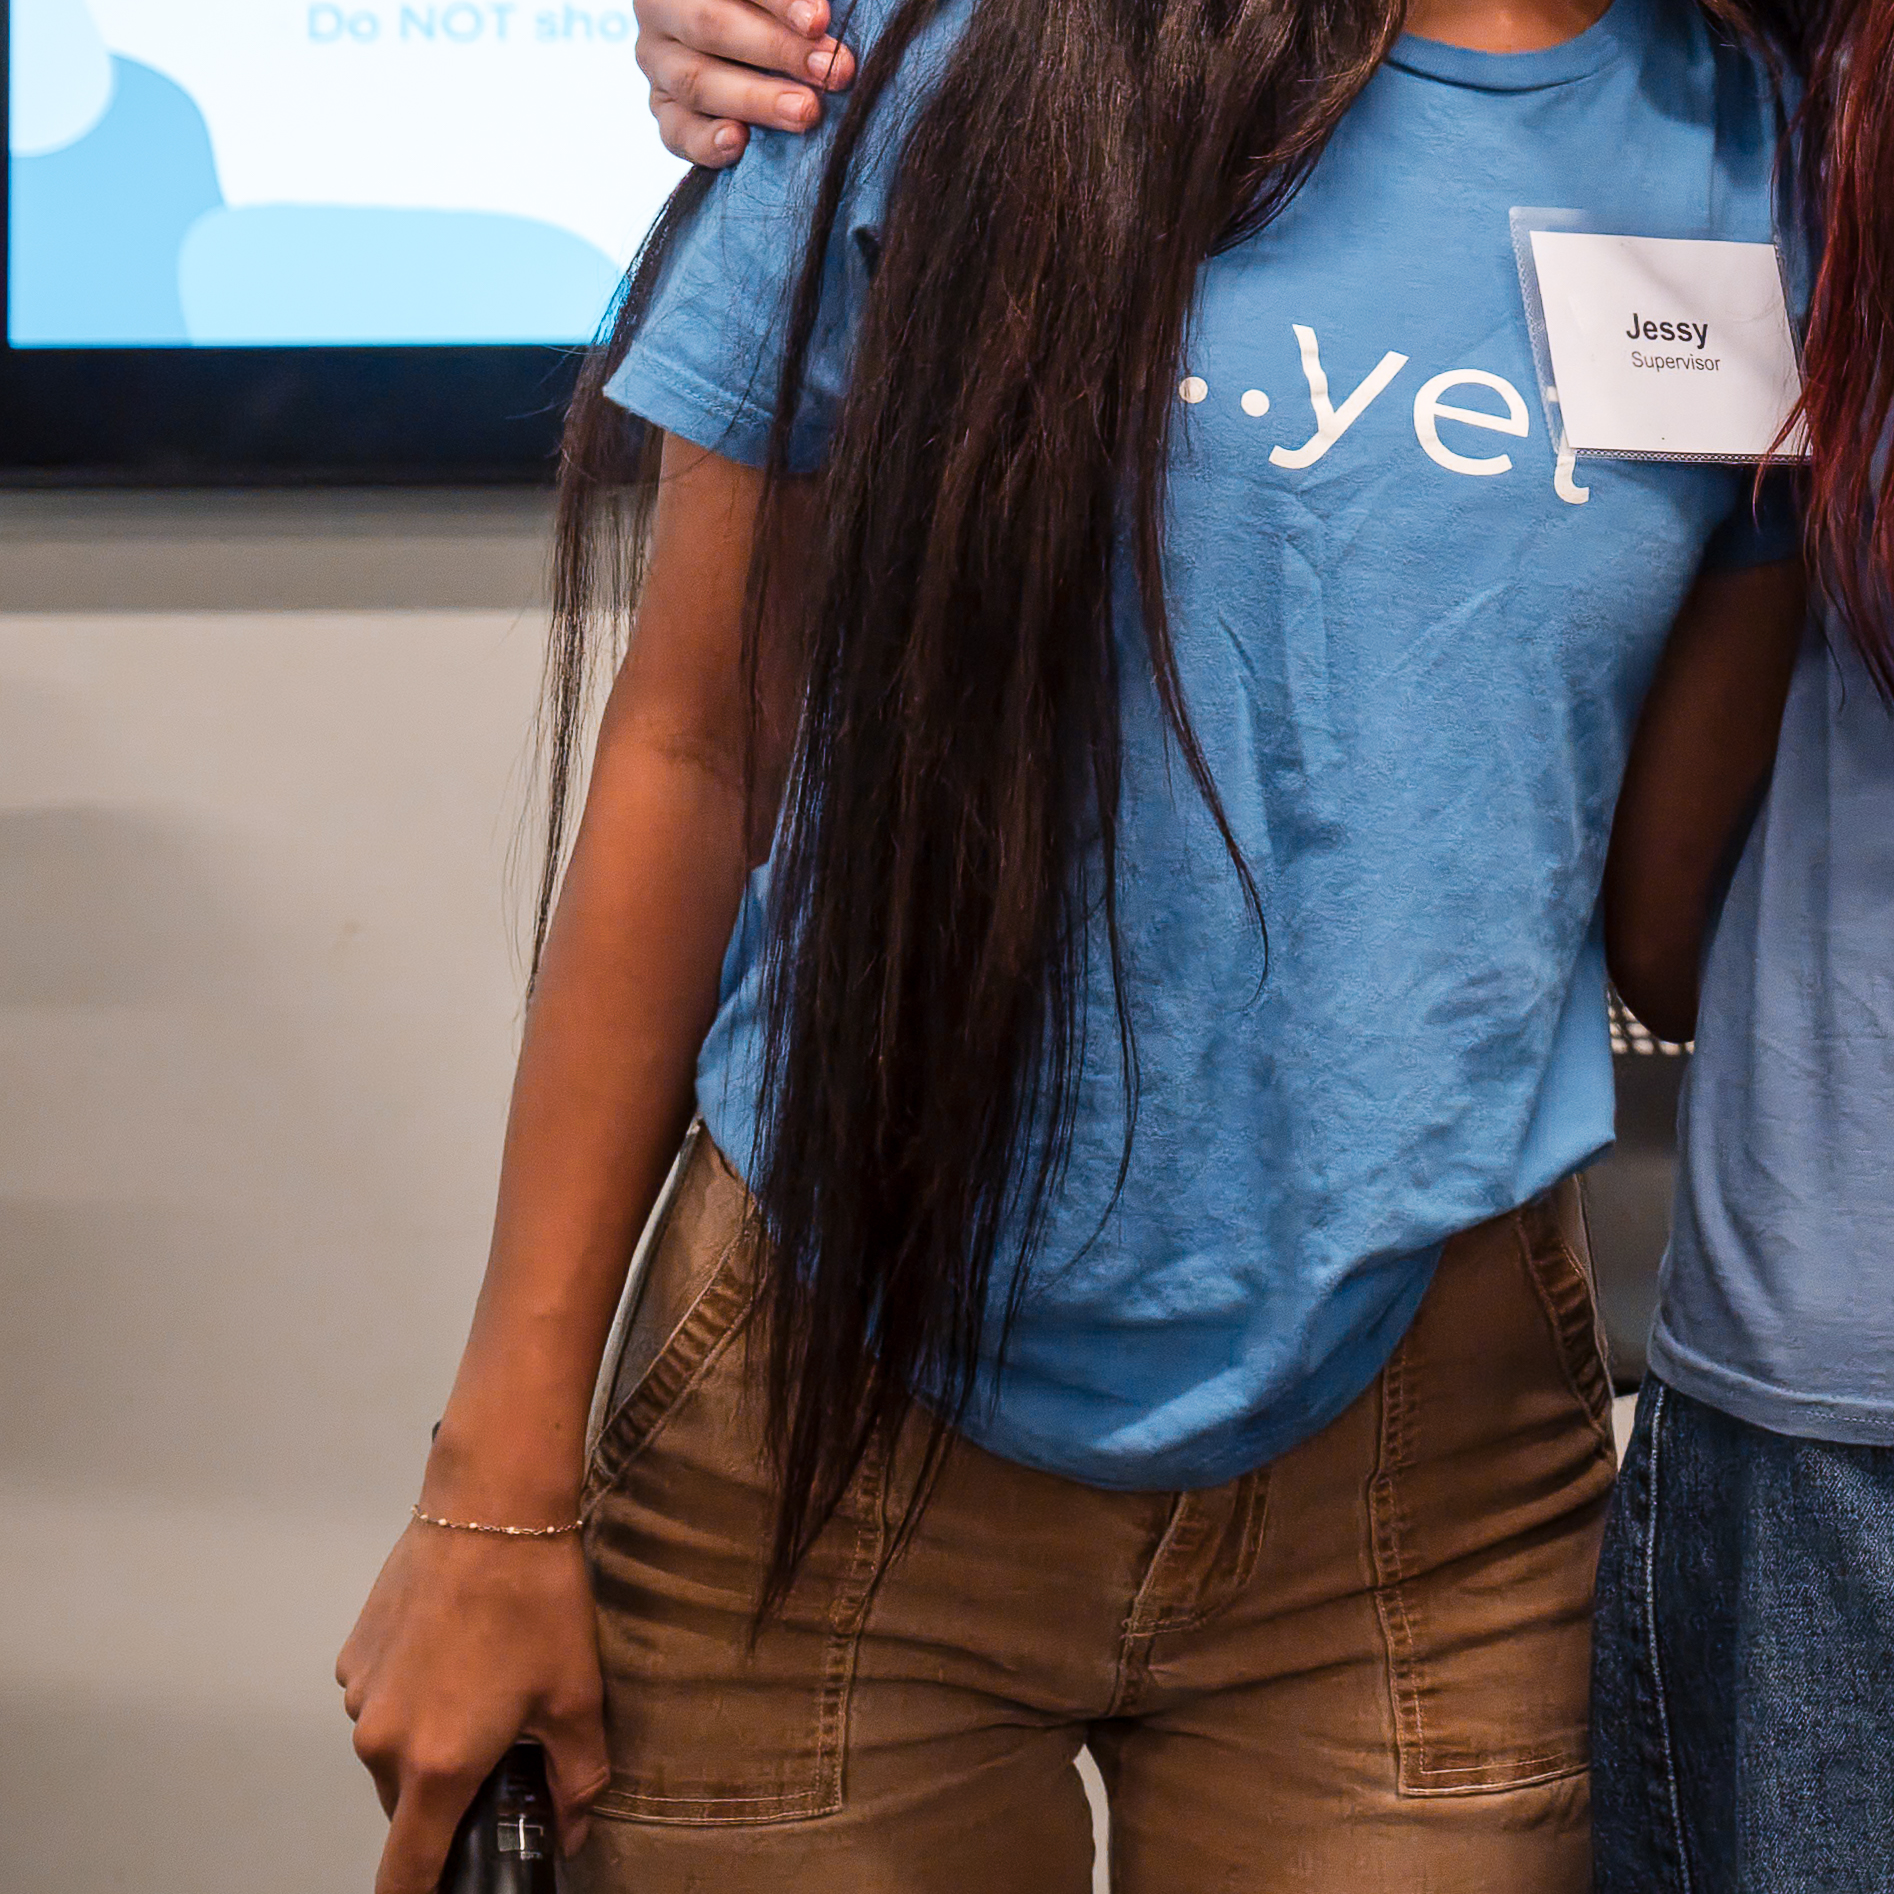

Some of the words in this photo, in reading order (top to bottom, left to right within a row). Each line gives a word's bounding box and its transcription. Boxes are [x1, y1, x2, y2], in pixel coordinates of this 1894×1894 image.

[305, 0, 383, 47] Do
[397, 0, 520, 46] NOT
[1626, 312, 1709, 350] Jessy
[1631, 350, 1721, 373] Supervisor
